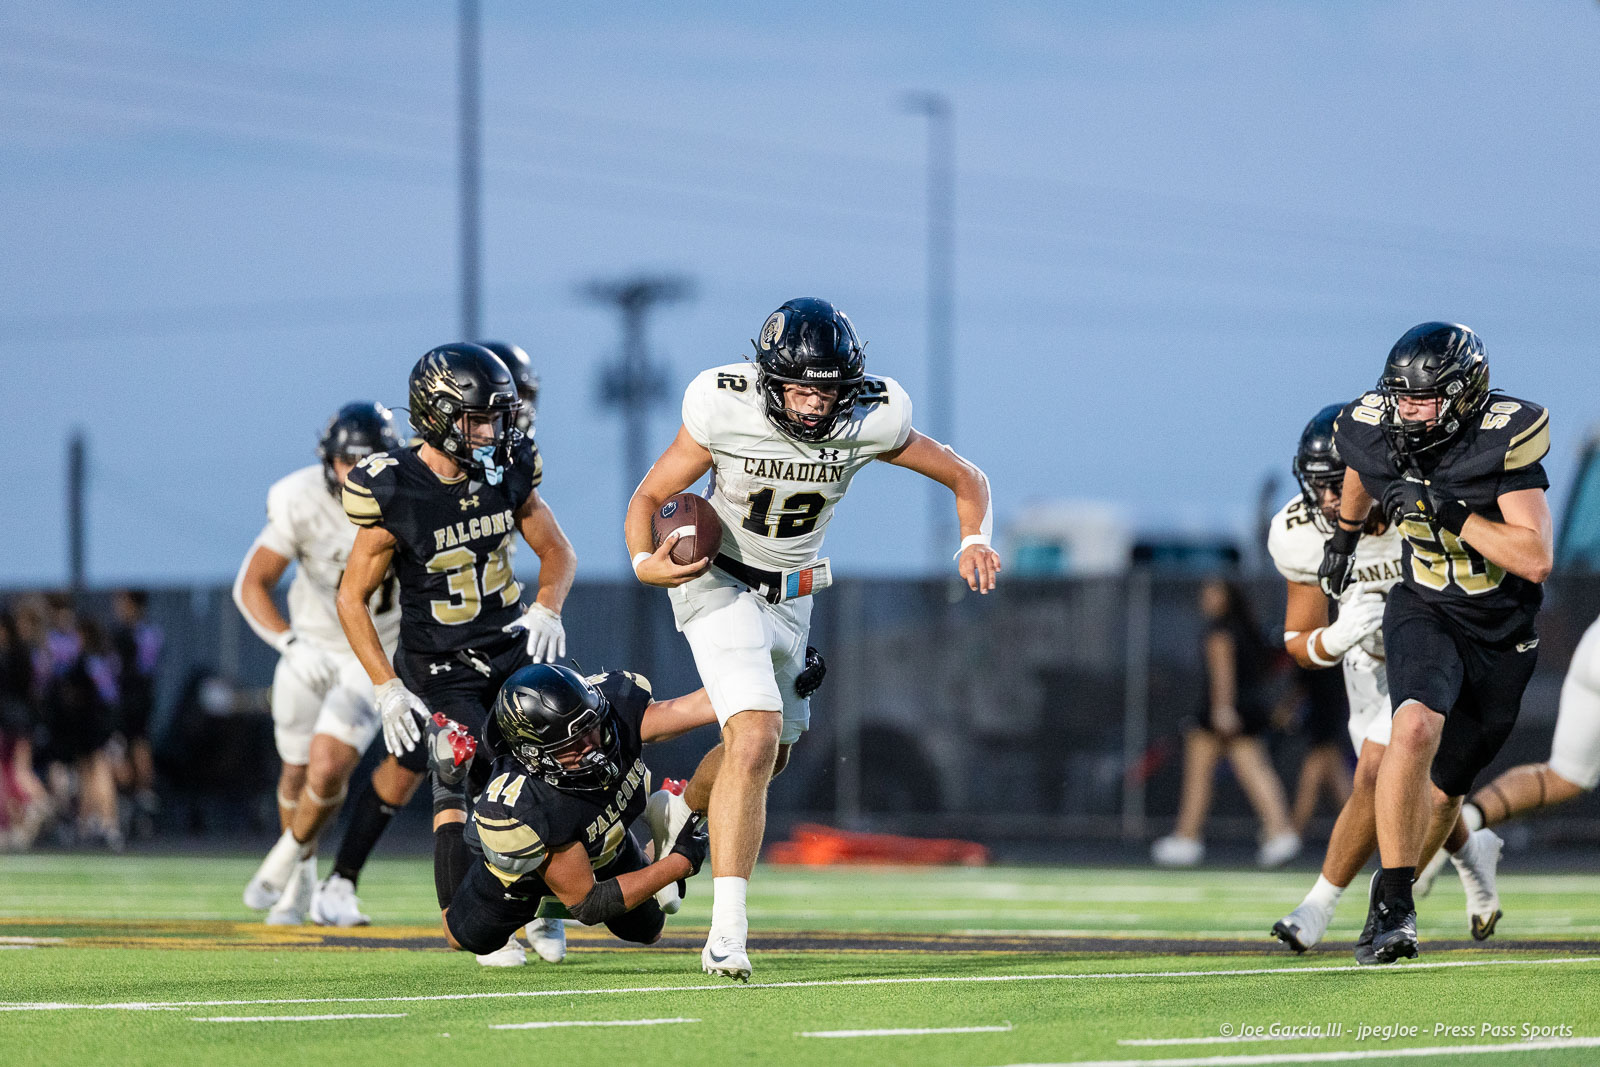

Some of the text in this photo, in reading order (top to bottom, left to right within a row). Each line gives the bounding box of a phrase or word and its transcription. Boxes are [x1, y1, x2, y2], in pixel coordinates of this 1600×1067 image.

[717, 372, 749, 393] 12
[806, 369, 839, 378] Riddell
[1479, 401, 1522, 430] 50
[744, 457, 845, 483] CANADIAN
[433, 509, 515, 551] FALCONS
[740, 486, 828, 539] 12
[1398, 519, 1507, 596] 50
[425, 545, 521, 626] 34
[485, 771, 527, 808] 44
[586, 757, 646, 843] FALCONS
